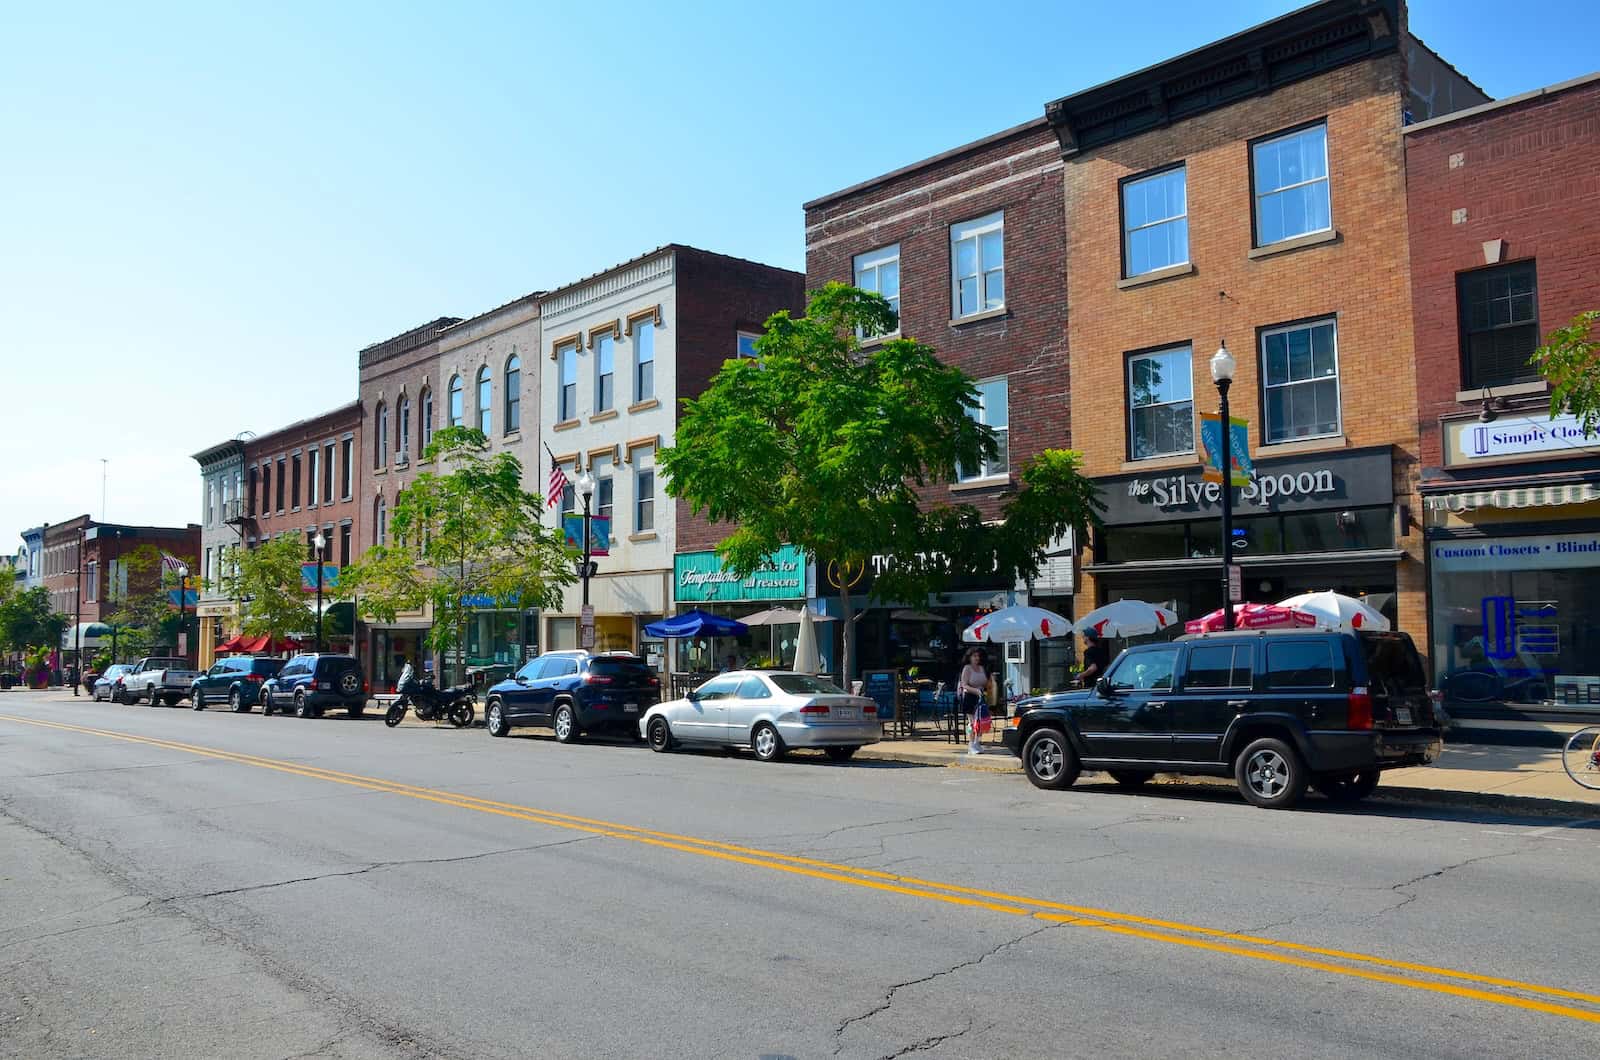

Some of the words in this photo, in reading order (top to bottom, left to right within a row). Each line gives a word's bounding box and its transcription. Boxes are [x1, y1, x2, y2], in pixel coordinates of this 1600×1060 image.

[1493, 430, 1546, 445] Simply
[1127, 479, 1149, 496] the
[1152, 475, 1223, 507] Silve
[1240, 468, 1335, 506] Spoon
[1435, 546, 1485, 558] Custom
[1489, 543, 1540, 555] Closets
[757, 578, 799, 588] reasons
